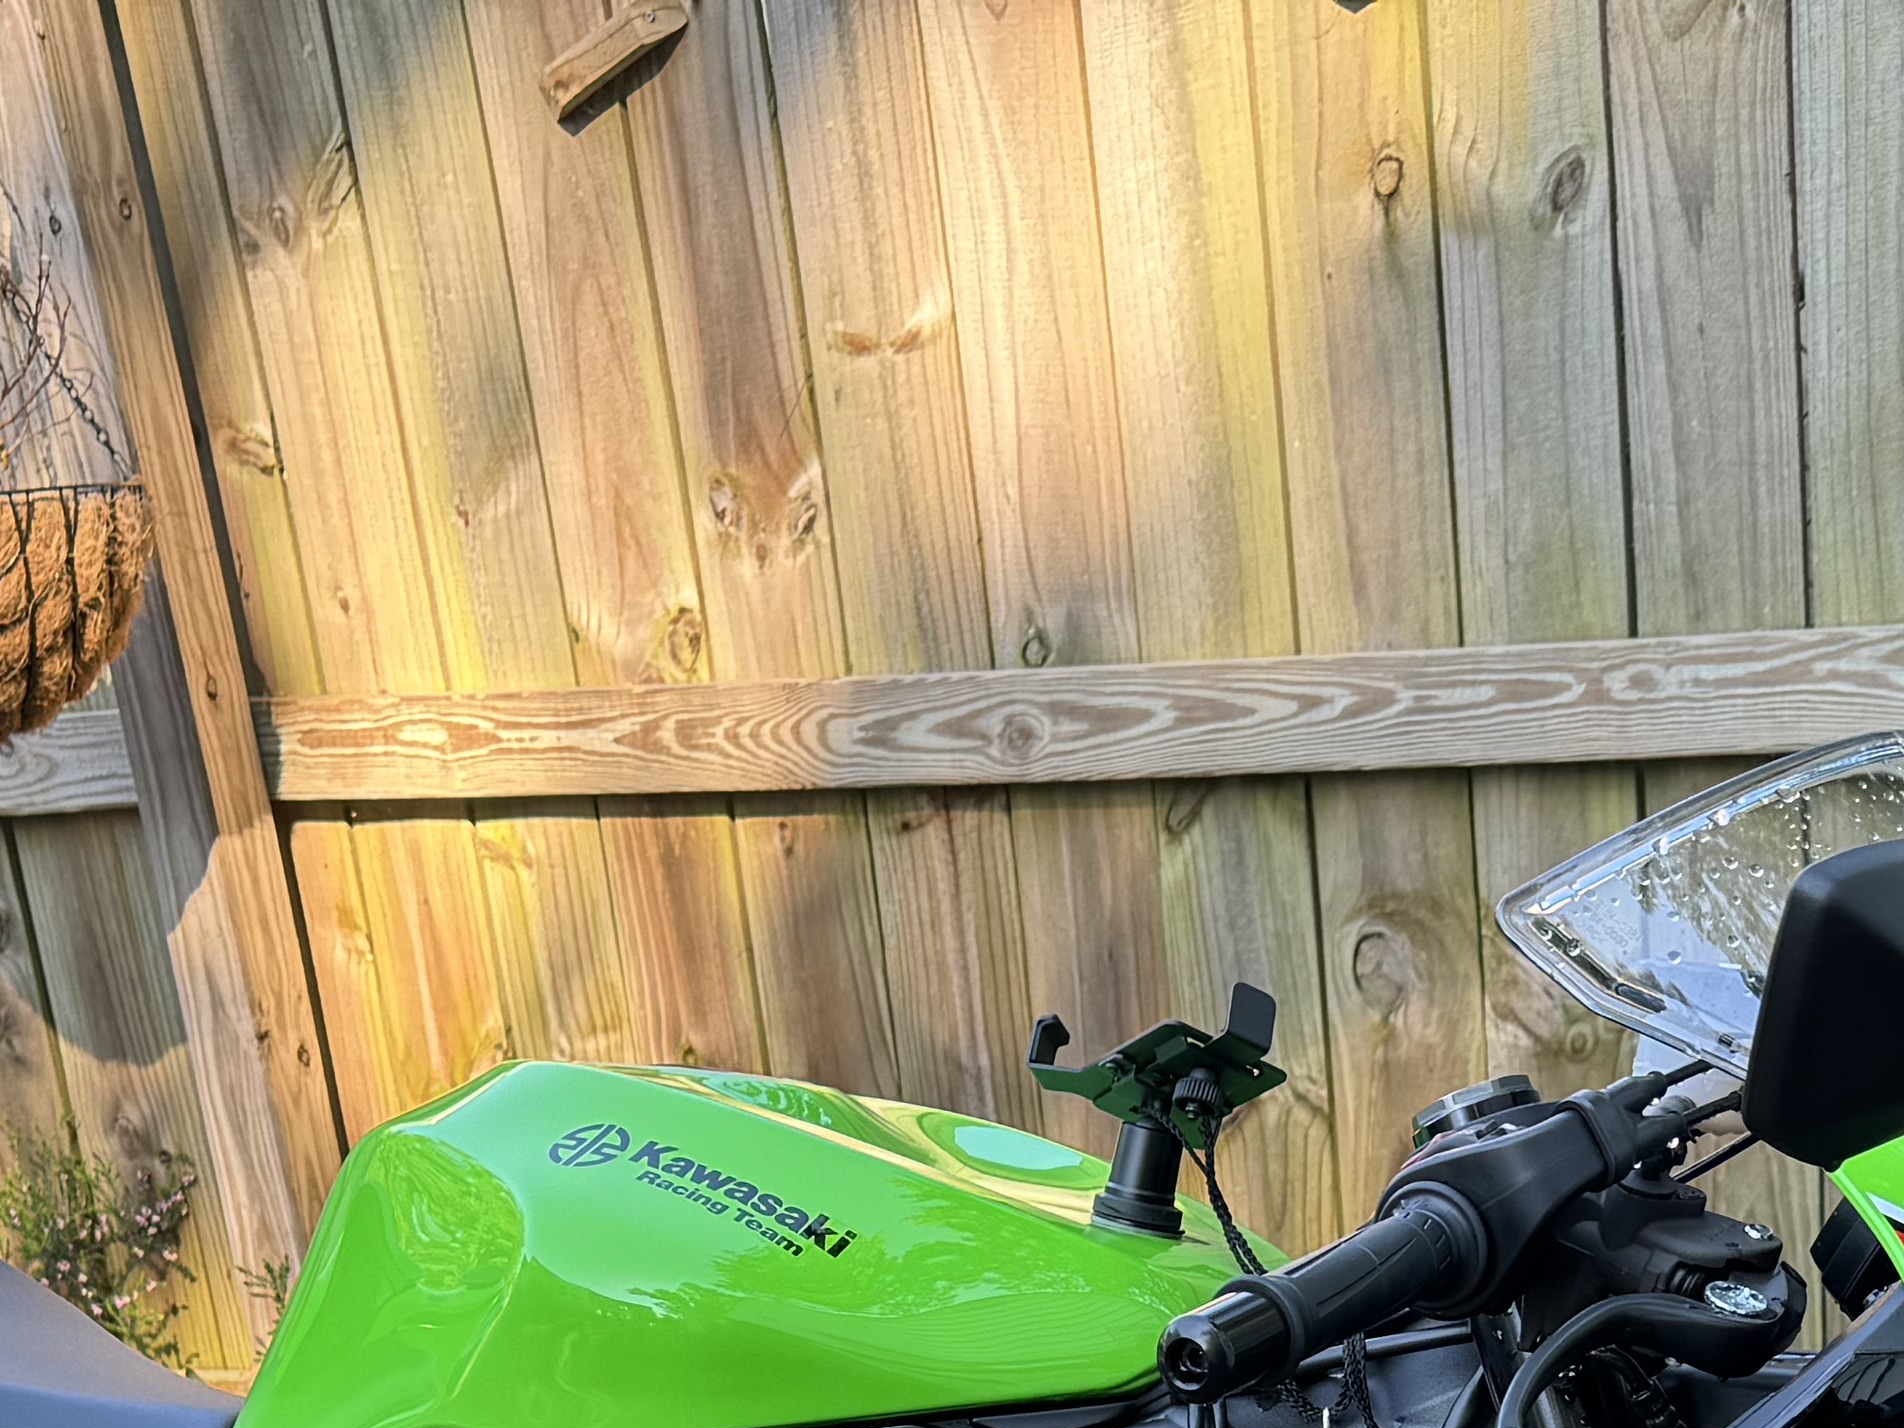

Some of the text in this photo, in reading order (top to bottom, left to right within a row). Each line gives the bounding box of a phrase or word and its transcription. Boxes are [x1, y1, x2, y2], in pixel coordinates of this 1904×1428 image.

[629, 1141, 857, 1258] Kawasaki
[636, 1170, 804, 1256] Racing Team
